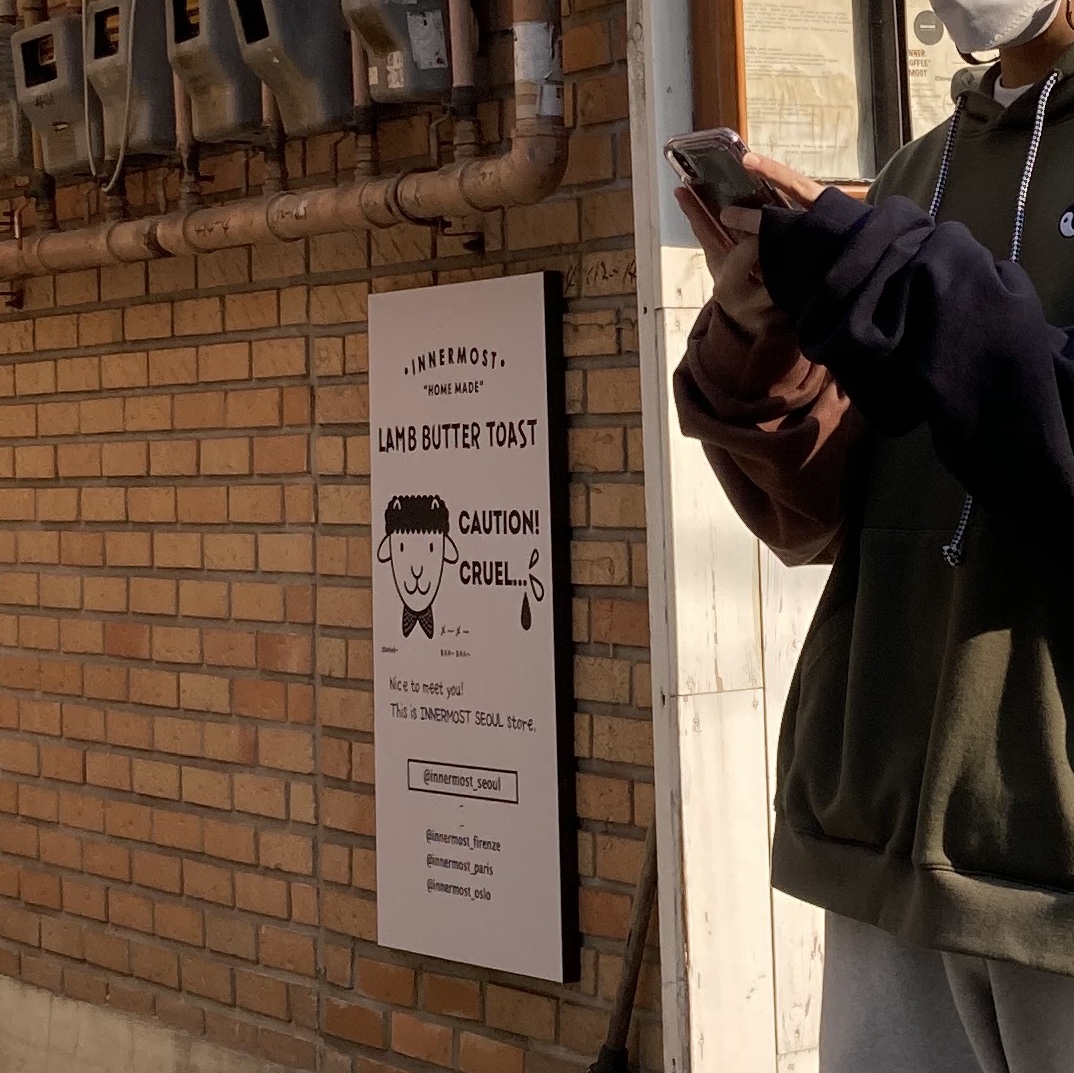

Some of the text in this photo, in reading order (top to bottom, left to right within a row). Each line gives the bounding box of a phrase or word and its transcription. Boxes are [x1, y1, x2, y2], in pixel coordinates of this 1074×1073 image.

[378, 418, 538, 454] LAMB BUTTER TOAST
[458, 509, 540, 535] CAUTION!
[459, 560, 528, 586] CRUEL...
[389, 676, 464, 700] Nice to meet you!
[390, 703, 408, 720] This
[410, 703, 418, 720] is
[420, 706, 472, 725] INNERMOST
[474, 710, 504, 728] SEOUL
[423, 768, 501, 792] @innermost_seoul
[425, 828, 501, 853] @innermost_firenze
[426, 853, 494, 876] @innermost_paris
[426, 878, 492, 902] @innermost_oslo
